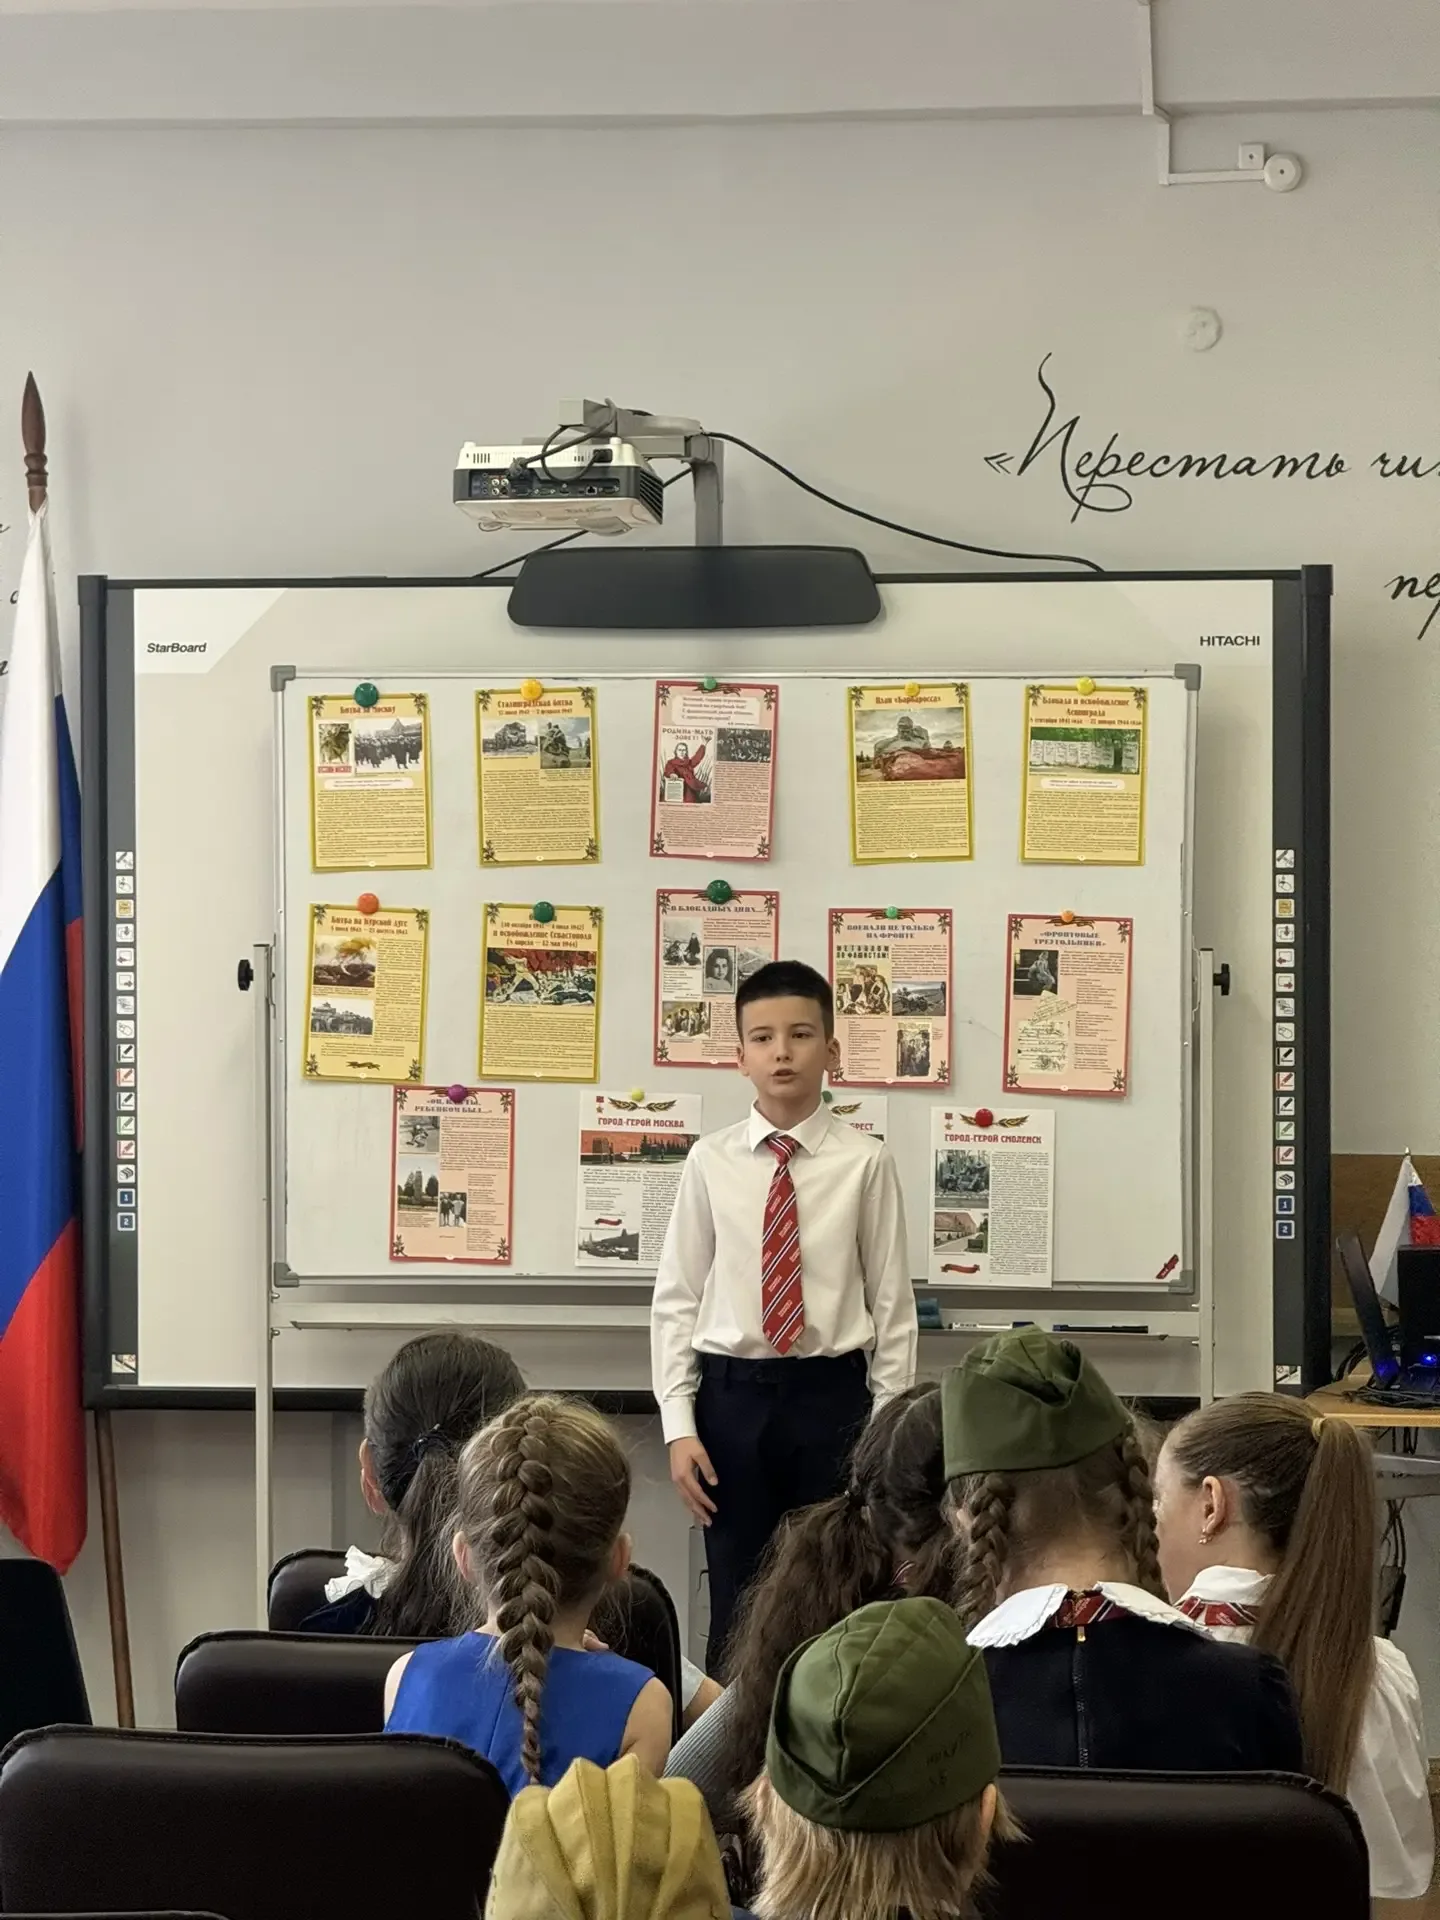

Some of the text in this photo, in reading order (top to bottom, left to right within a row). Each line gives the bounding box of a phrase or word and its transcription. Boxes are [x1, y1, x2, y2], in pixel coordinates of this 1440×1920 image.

[984, 352, 1352, 523] «Перестать
[1200, 636, 1260, 646] HITACHI
[147, 642, 207, 653] StarBoard
[498, 700, 551, 708] Сталинградская
[876, 696, 892, 704] План
[1080, 698, 1130, 706] освобождение
[1067, 708, 1106, 717] Ленинграда
[331, 916, 352, 924] Битва
[500, 930, 548, 939] освобождение
[550, 931, 592, 940] Севастополя
[1040, 931, 1100, 939] «ФРОНТОВЫЕ
[598, 1118, 684, 1128] ГОРОД-ГЕРОЙ МОСКВА
[945, 1134, 1042, 1144] ГОРОД-ГЕРОЙ СМОЛЕНСК
[124, 1194, 129, 1202] 1
[1283, 1201, 1287, 1209] 1
[124, 1218, 129, 1226] 2
[1282, 1226, 1288, 1234] 2
